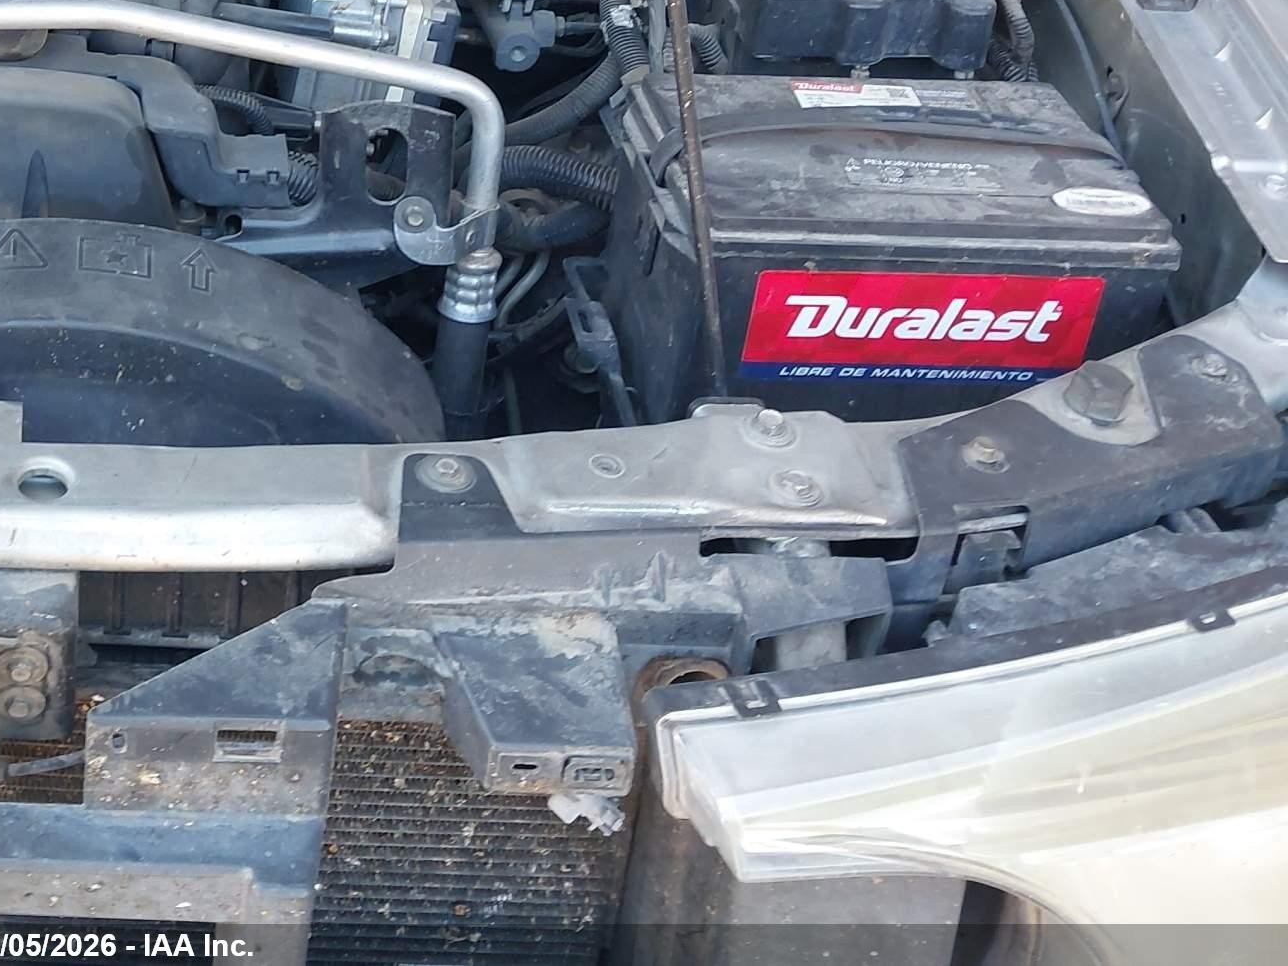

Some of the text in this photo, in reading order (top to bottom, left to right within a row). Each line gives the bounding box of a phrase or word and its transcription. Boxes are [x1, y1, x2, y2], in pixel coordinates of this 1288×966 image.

[796, 81, 856, 92] Duralast
[784, 294, 1063, 343] Duralast
[779, 366, 1033, 381] LIBRE DE MANTENIMIENTO
